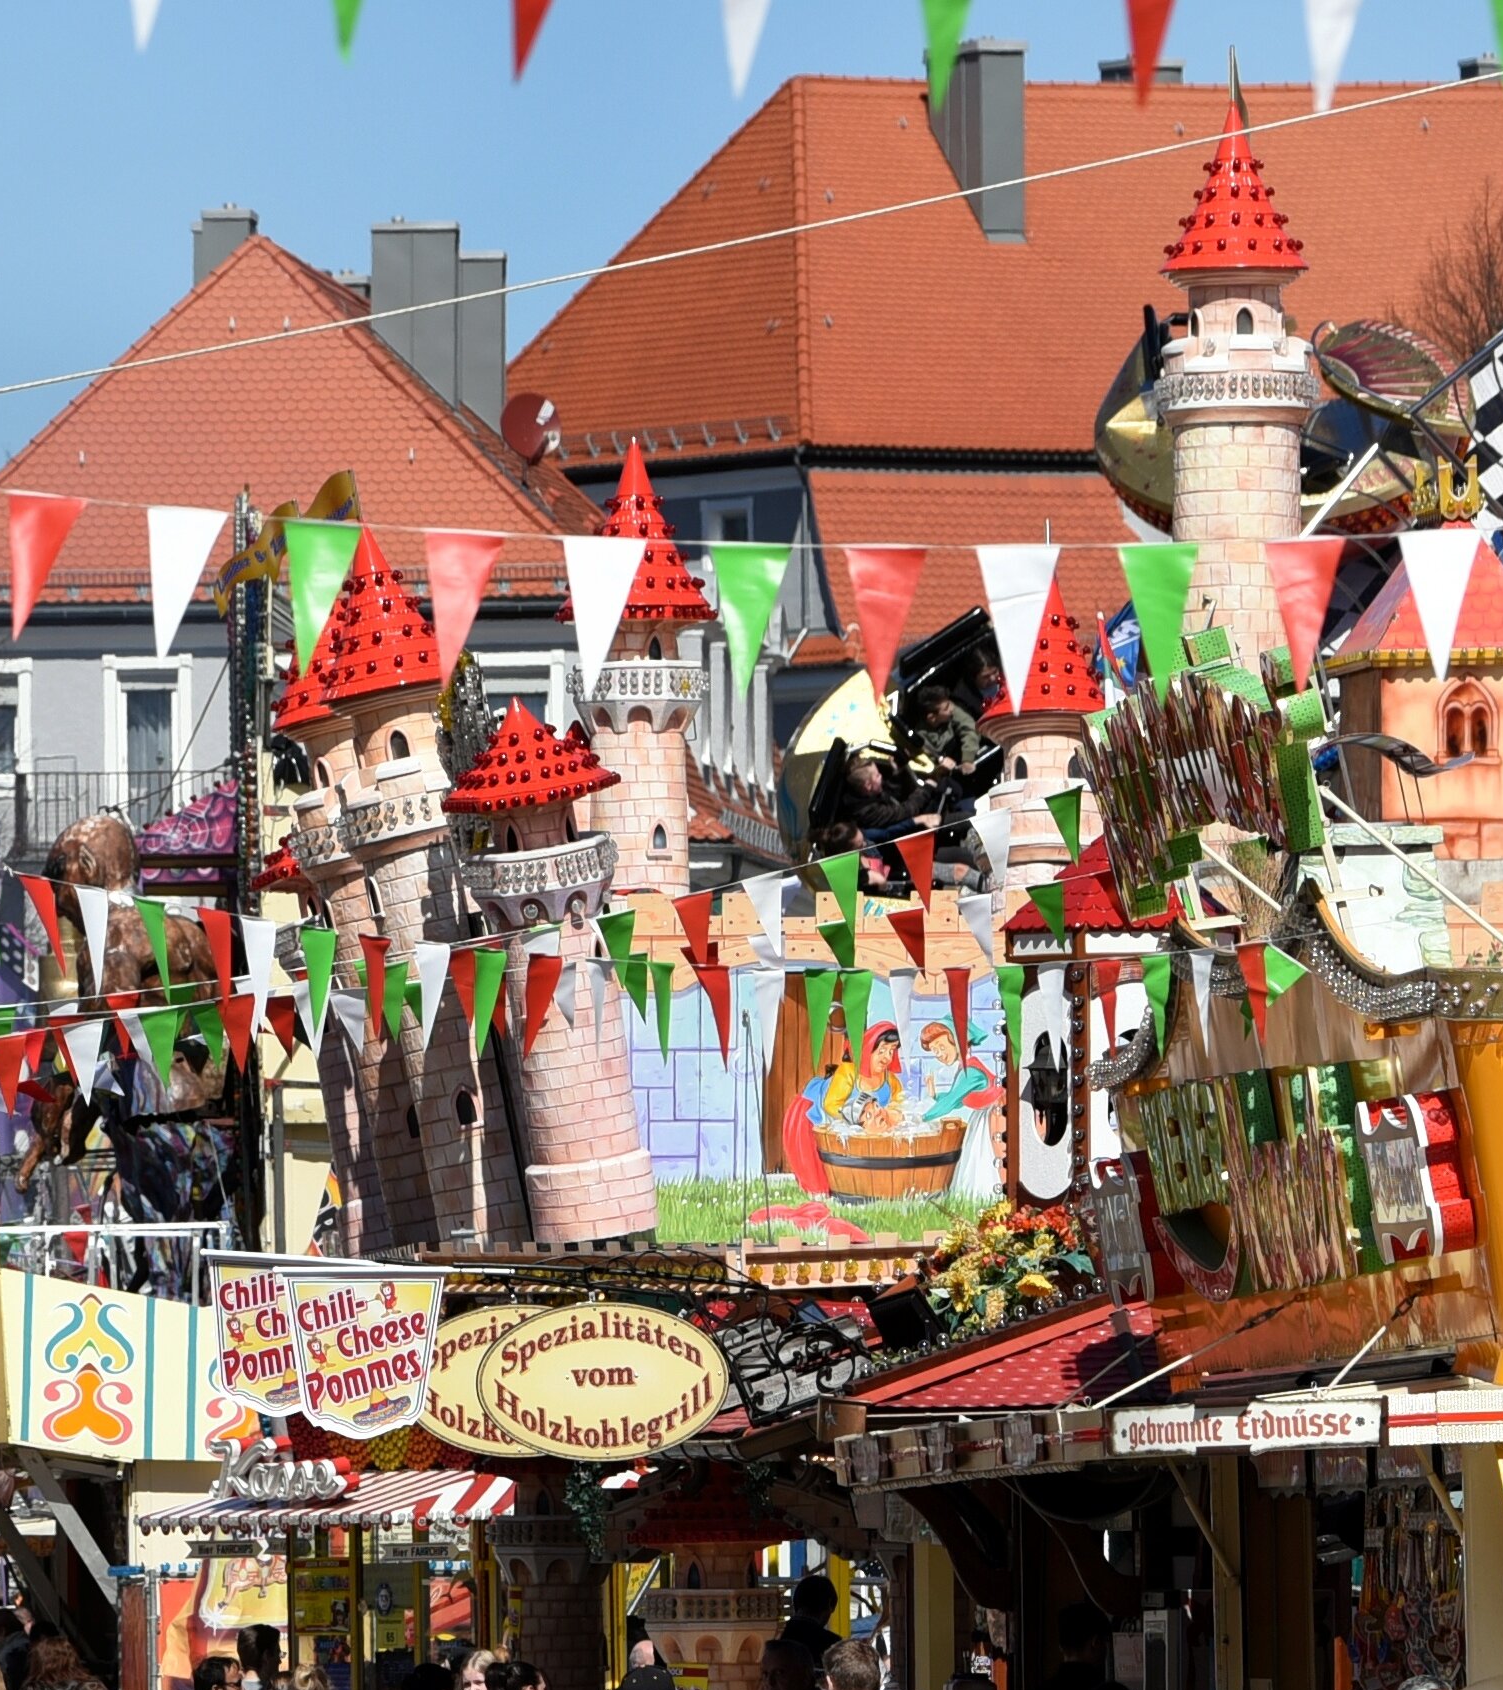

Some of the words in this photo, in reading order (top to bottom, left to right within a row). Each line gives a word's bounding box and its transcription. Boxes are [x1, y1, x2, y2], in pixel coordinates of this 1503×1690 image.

[219, 1272, 285, 1312] Chili-
[297, 1288, 368, 1332] Chili-
[336, 1311, 428, 1358] Cheese
[501, 1310, 706, 1377] Spezialitäten
[305, 1349, 423, 1410] Pommes
[571, 1365, 636, 1387] vom
[494, 1371, 713, 1449] Holzkohlegrill
[1128, 1412, 1223, 1450] gebrannte
[1235, 1408, 1353, 1440] Erdnüsse
[208, 1437, 347, 1500] Kasse
